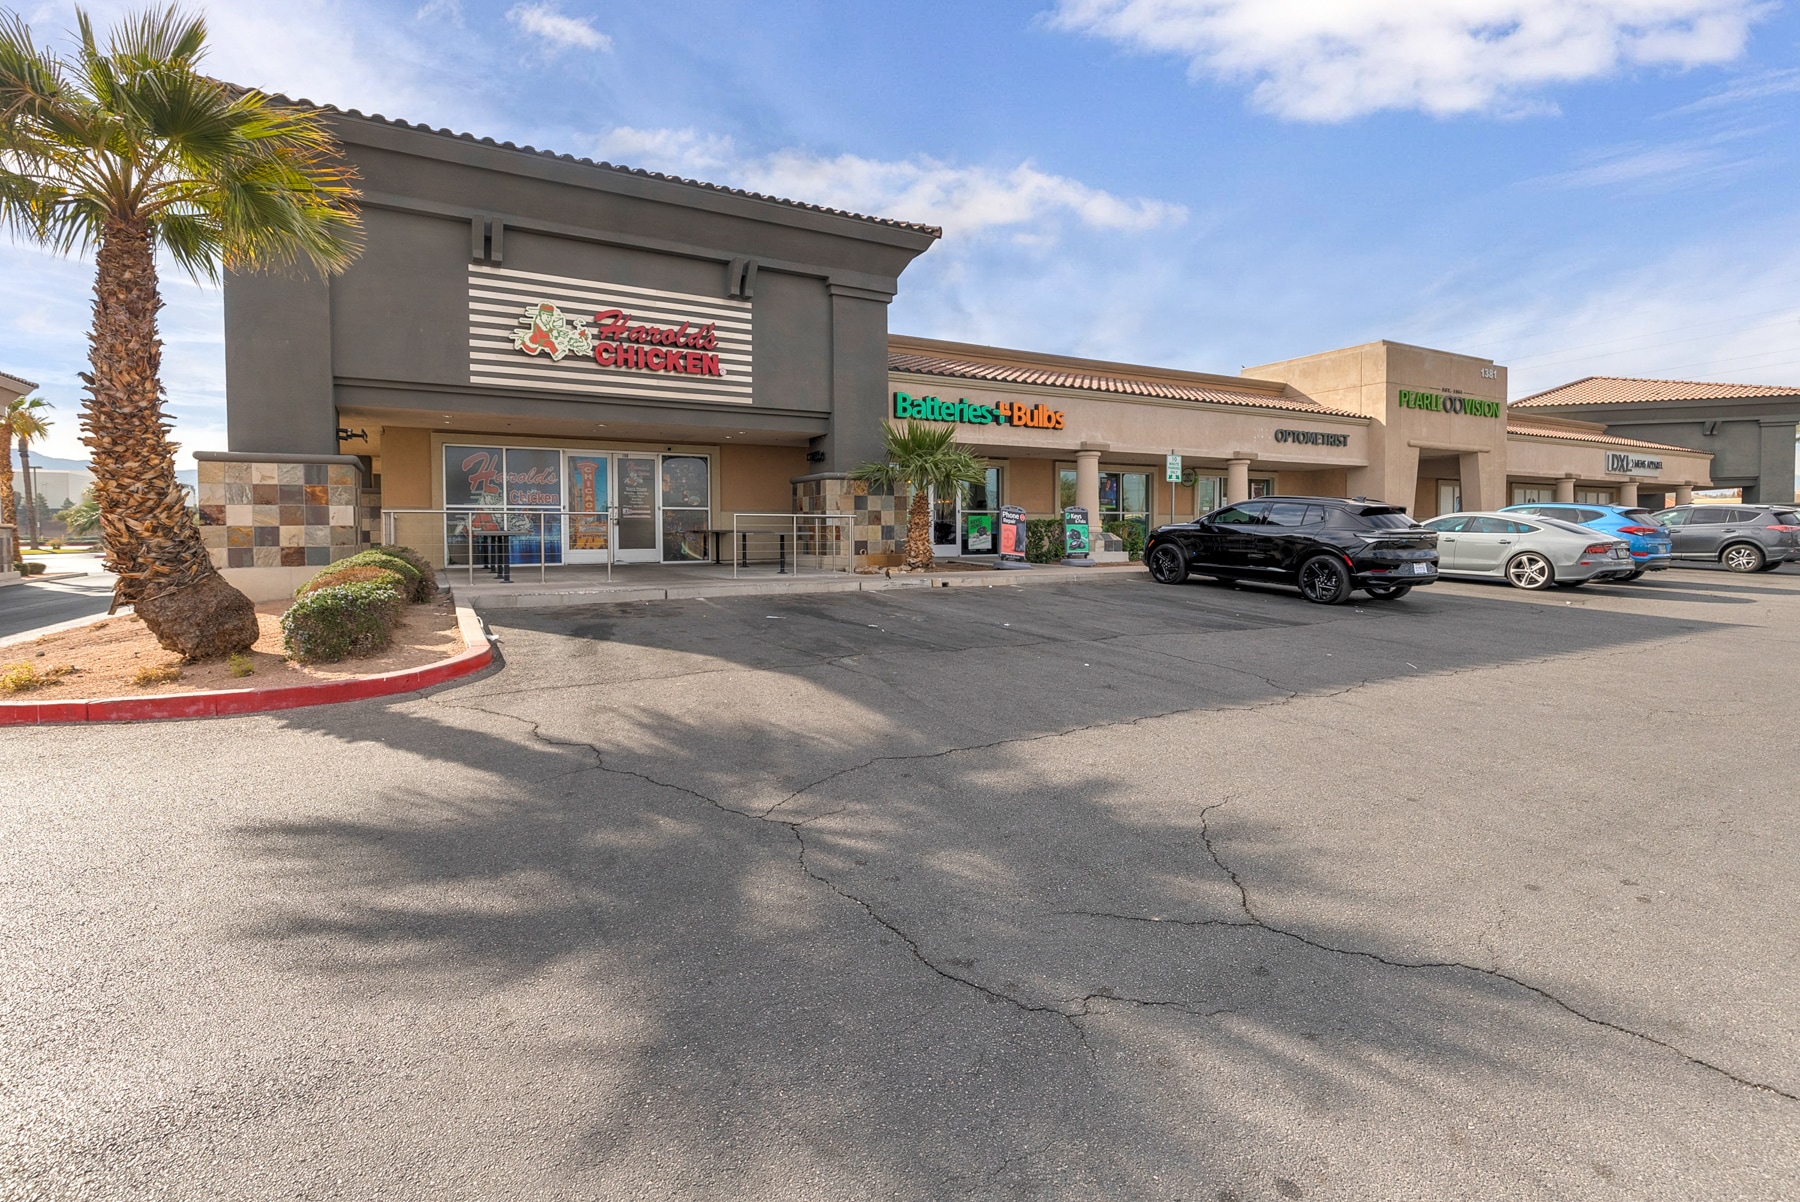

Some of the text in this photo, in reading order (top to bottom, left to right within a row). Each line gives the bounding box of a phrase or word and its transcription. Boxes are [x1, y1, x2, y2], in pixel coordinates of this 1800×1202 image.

[594, 309, 719, 350] Harold's
[594, 342, 720, 376] CHICKEN
[1480, 368, 1497, 379] 1381
[893, 392, 993, 424] Batteries
[1010, 402, 1066, 430] Bulbs
[1399, 390, 1501, 418] PEARLE VISION
[1274, 428, 1350, 447] OPTOMETRIST
[461, 451, 558, 494] Harold's
[509, 490, 560, 505] Chicken
[1002, 511, 1020, 520] Phone
[1070, 513, 1083, 521] Keys
